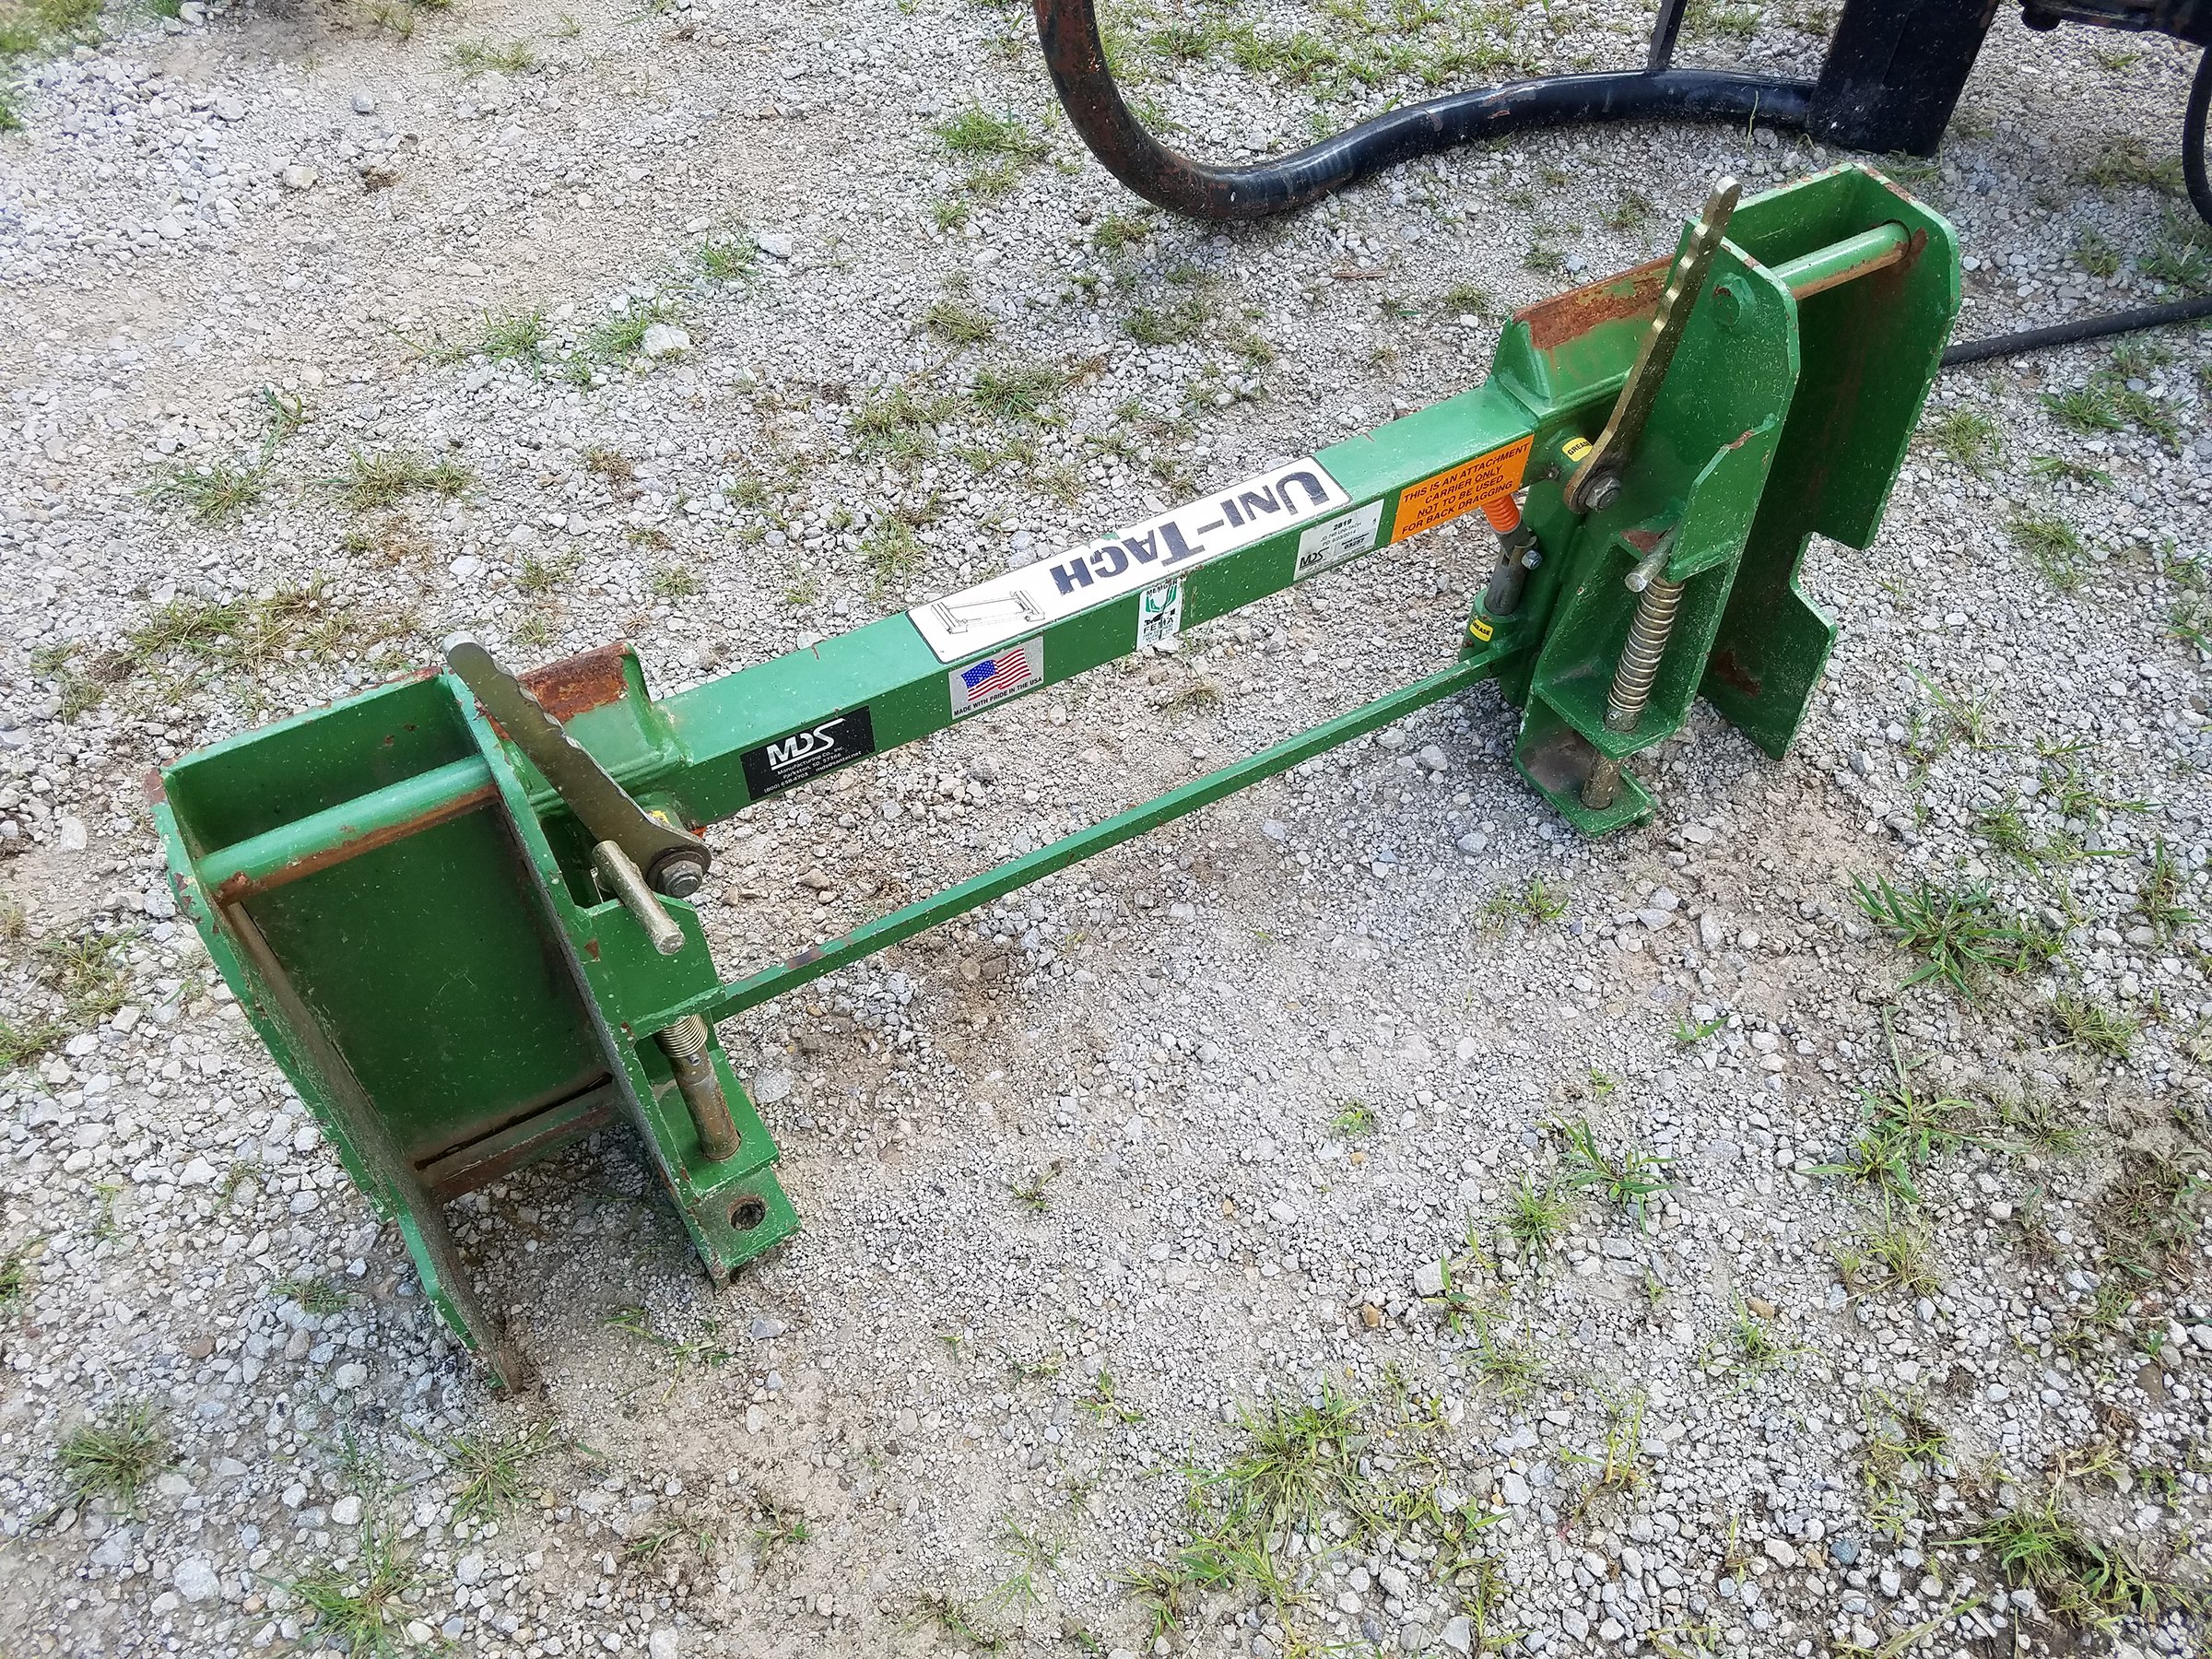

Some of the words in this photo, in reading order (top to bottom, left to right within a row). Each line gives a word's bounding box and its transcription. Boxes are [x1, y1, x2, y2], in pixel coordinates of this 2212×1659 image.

[1404, 487, 1428, 503] THIS
[1430, 481, 1441, 492] IS
[1441, 475, 1458, 487] AN
[1460, 442, 1530, 479] ATTACHMENT
[1425, 477, 1472, 504] CARRIER
[1475, 465, 1503, 484] ONLY
[1402, 520, 1424, 535] FOR
[1426, 507, 1455, 524] BACK
[1458, 480, 1513, 511] DRAGGING
[1417, 502, 1439, 519] NOT
[1443, 494, 1456, 505] TO
[1458, 488, 1474, 500] BE
[1477, 475, 1504, 493] USED
[1299, 547, 1330, 570] MDS
[1147, 580, 1177, 596] MEMBR
[1144, 618, 1174, 633] FEMA
[954, 705, 971, 716] MADE
[972, 698, 989, 709] WITH
[990, 691, 1008, 701] PRIDE
[1017, 681, 1030, 691] THE
[1030, 677, 1042, 687] USA
[766, 717, 846, 771] MDS
[777, 753, 822, 776] Manufacturing
[834, 745, 845, 754] Inc.
[763, 782, 781, 794] (800)
